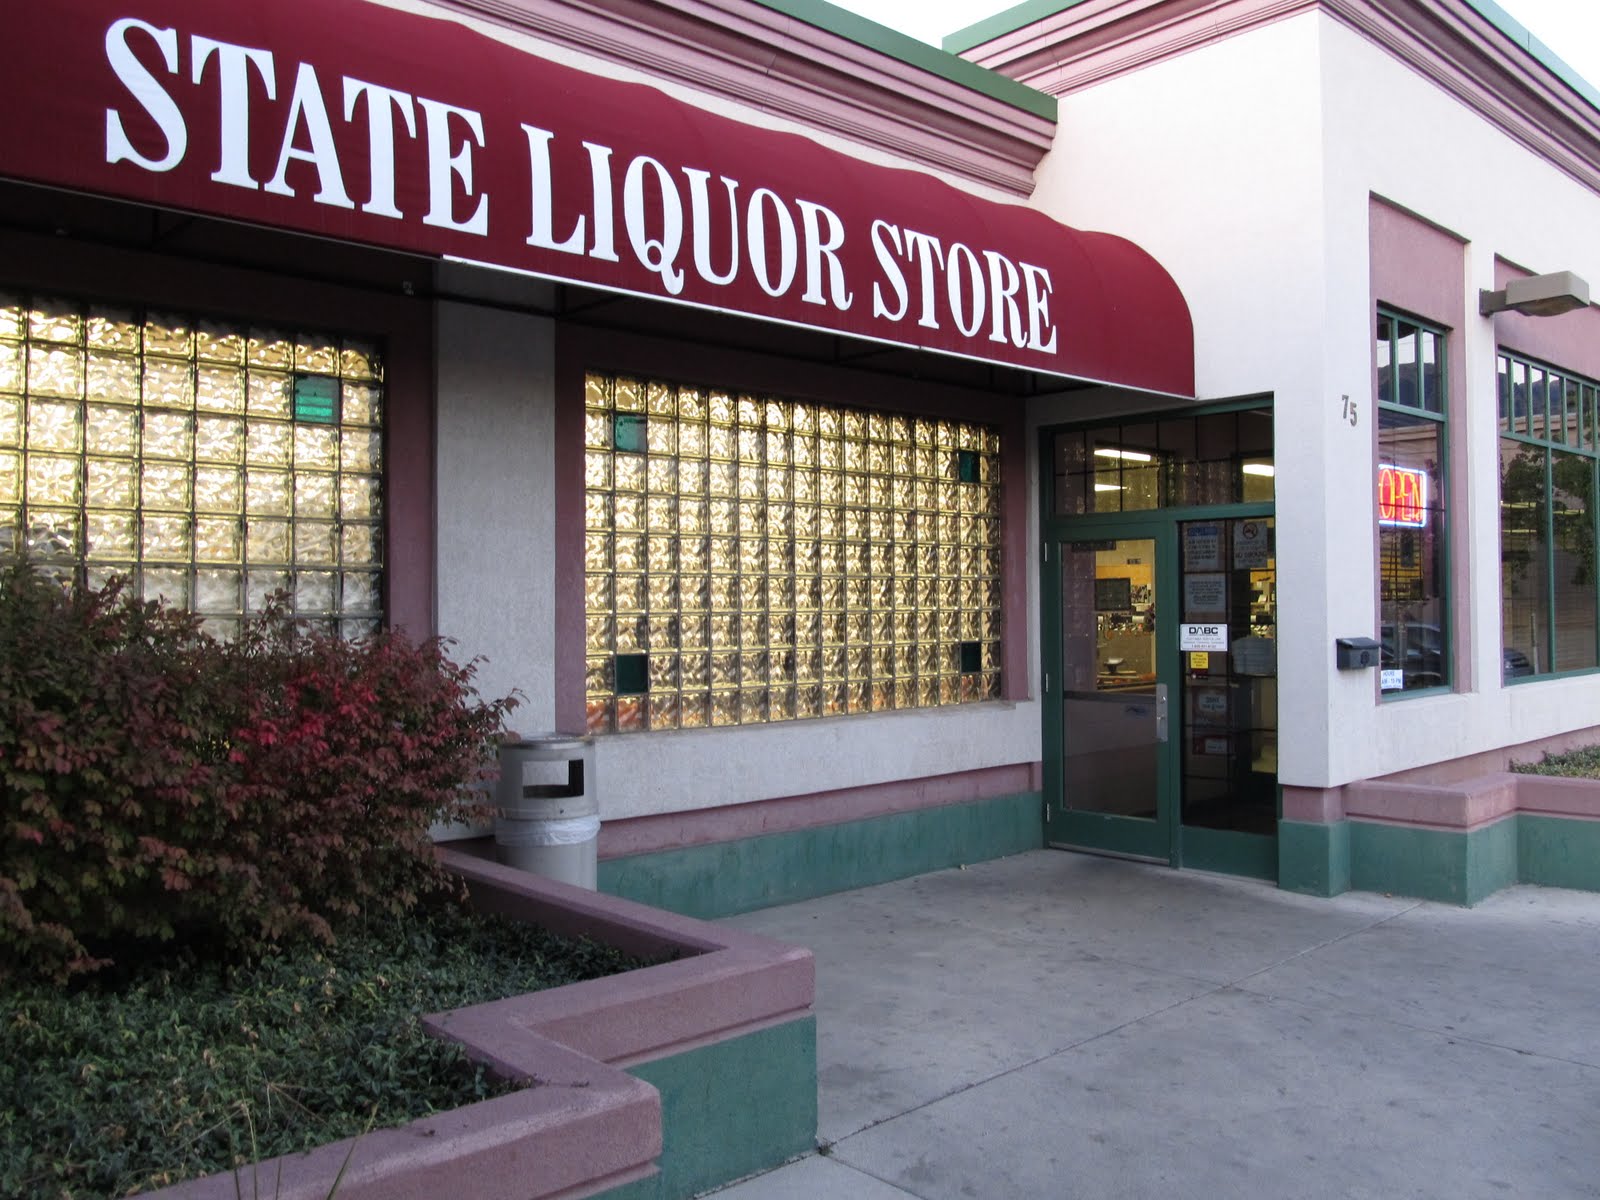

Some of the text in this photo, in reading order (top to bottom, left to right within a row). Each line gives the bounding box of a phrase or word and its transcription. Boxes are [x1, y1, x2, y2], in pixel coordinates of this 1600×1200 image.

[105, 18, 1057, 355] STATE LIQUOR STORE
[1341, 394, 1358, 427] 75
[1379, 469, 1423, 522] OPEN
[1189, 626, 1218, 634] DABC
